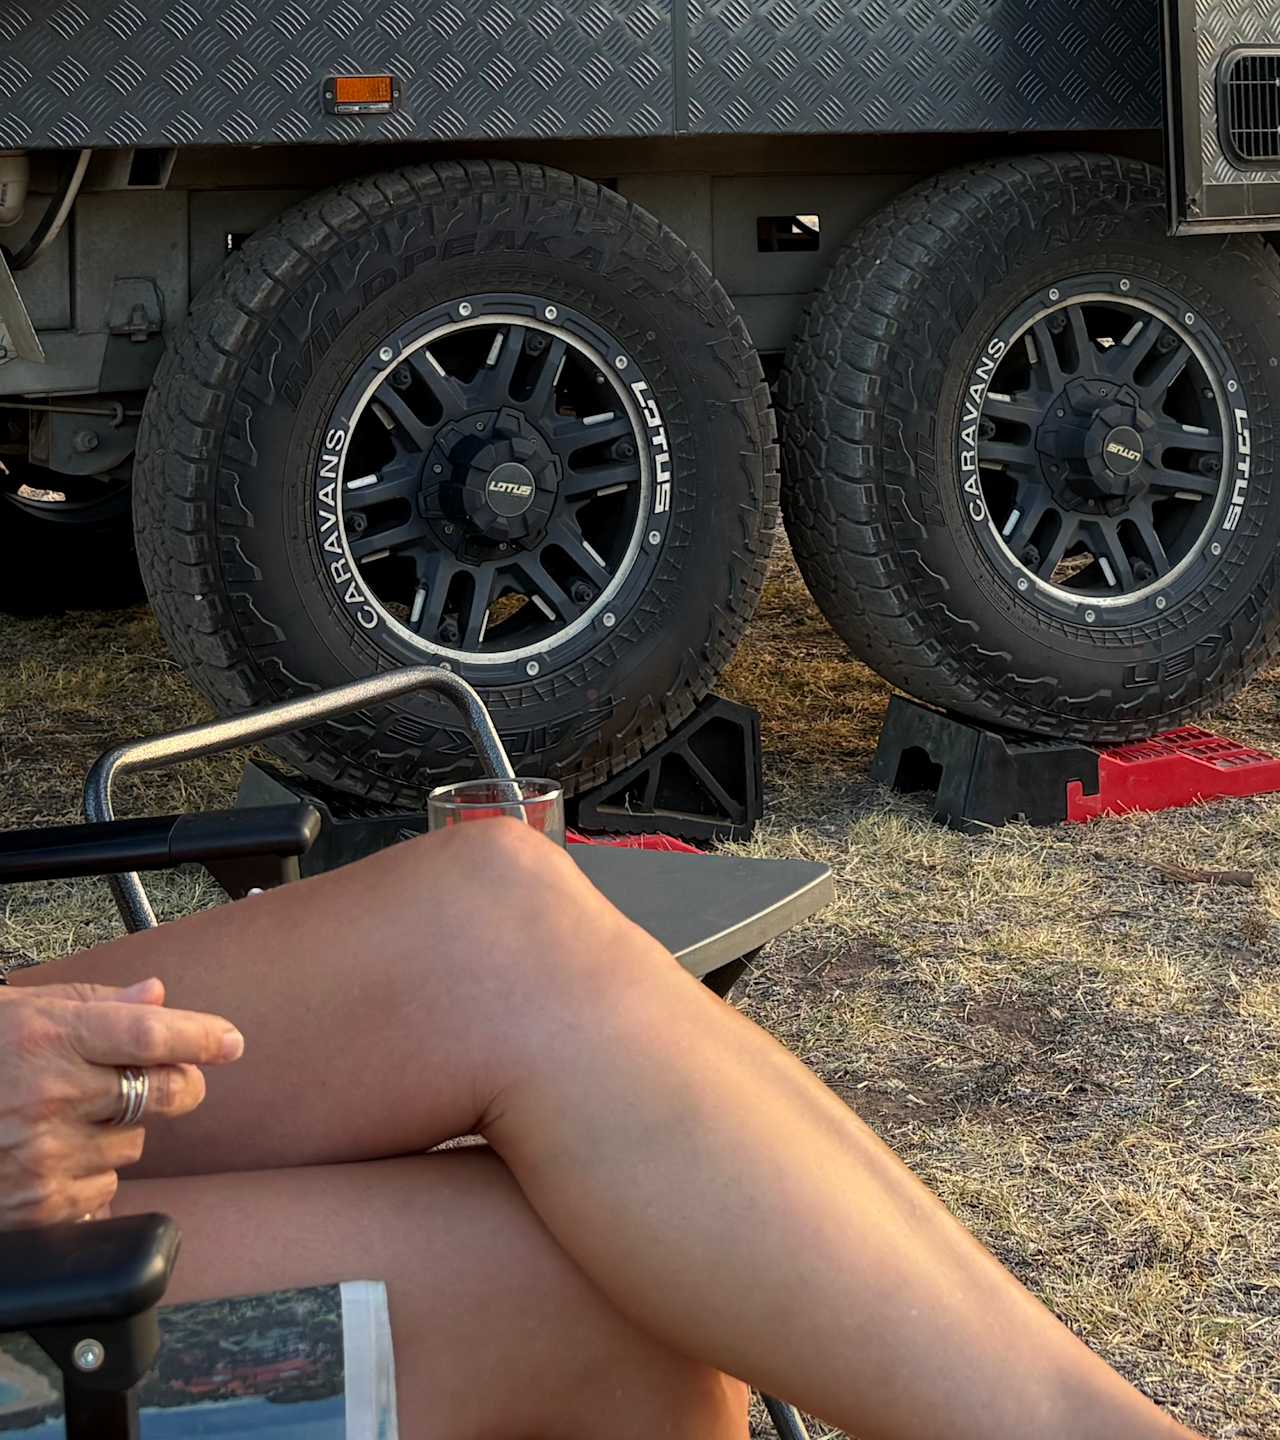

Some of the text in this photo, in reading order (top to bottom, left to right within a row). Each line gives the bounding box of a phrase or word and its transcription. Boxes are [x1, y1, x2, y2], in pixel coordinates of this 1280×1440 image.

[489, 481, 533, 495] LOTUS
[629, 380, 672, 516] LOTUS
[960, 336, 1007, 522] CARAVANS
[1106, 443, 1141, 462] LOTUS
[1221, 408, 1251, 532] LOTUS
[314, 426, 379, 630] CARAVANS
